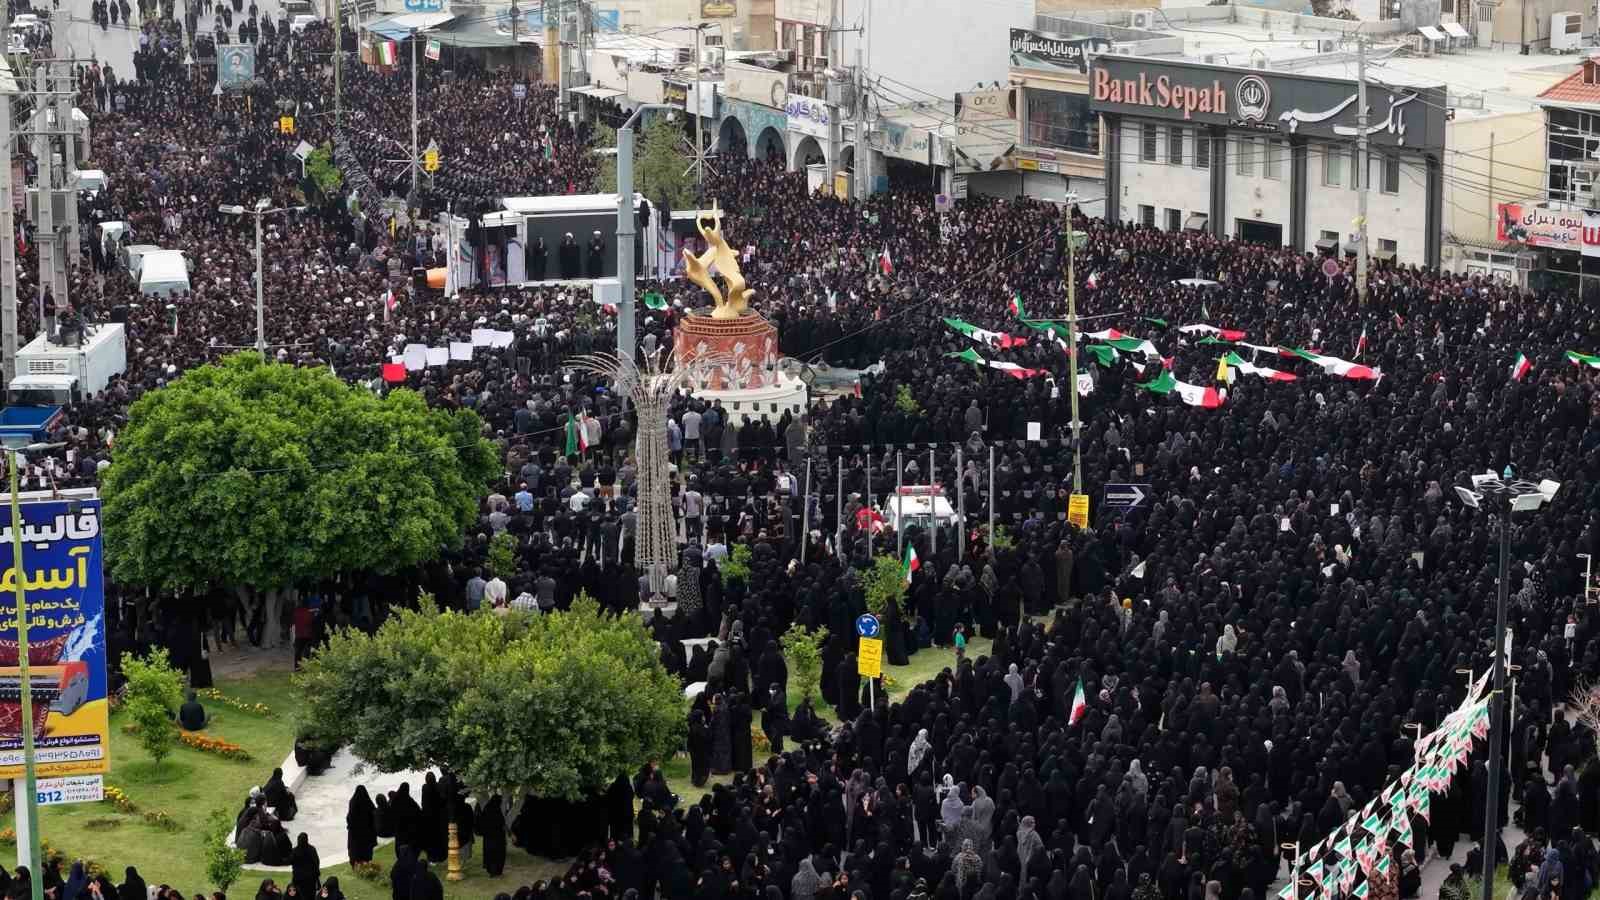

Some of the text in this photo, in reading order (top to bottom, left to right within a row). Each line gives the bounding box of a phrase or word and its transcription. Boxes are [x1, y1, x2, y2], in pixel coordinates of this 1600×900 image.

[1050, 41, 1081, 58] موبایل
[1093, 67, 1228, 119] Bank Sepah
[1333, 91, 1419, 146] بانک
[31, 599, 60, 613] حمام
[61, 597, 80, 611] یک
[47, 619, 54, 629] و
[55, 612, 85, 628] فرش
[37, 790, 62, 803] B12
